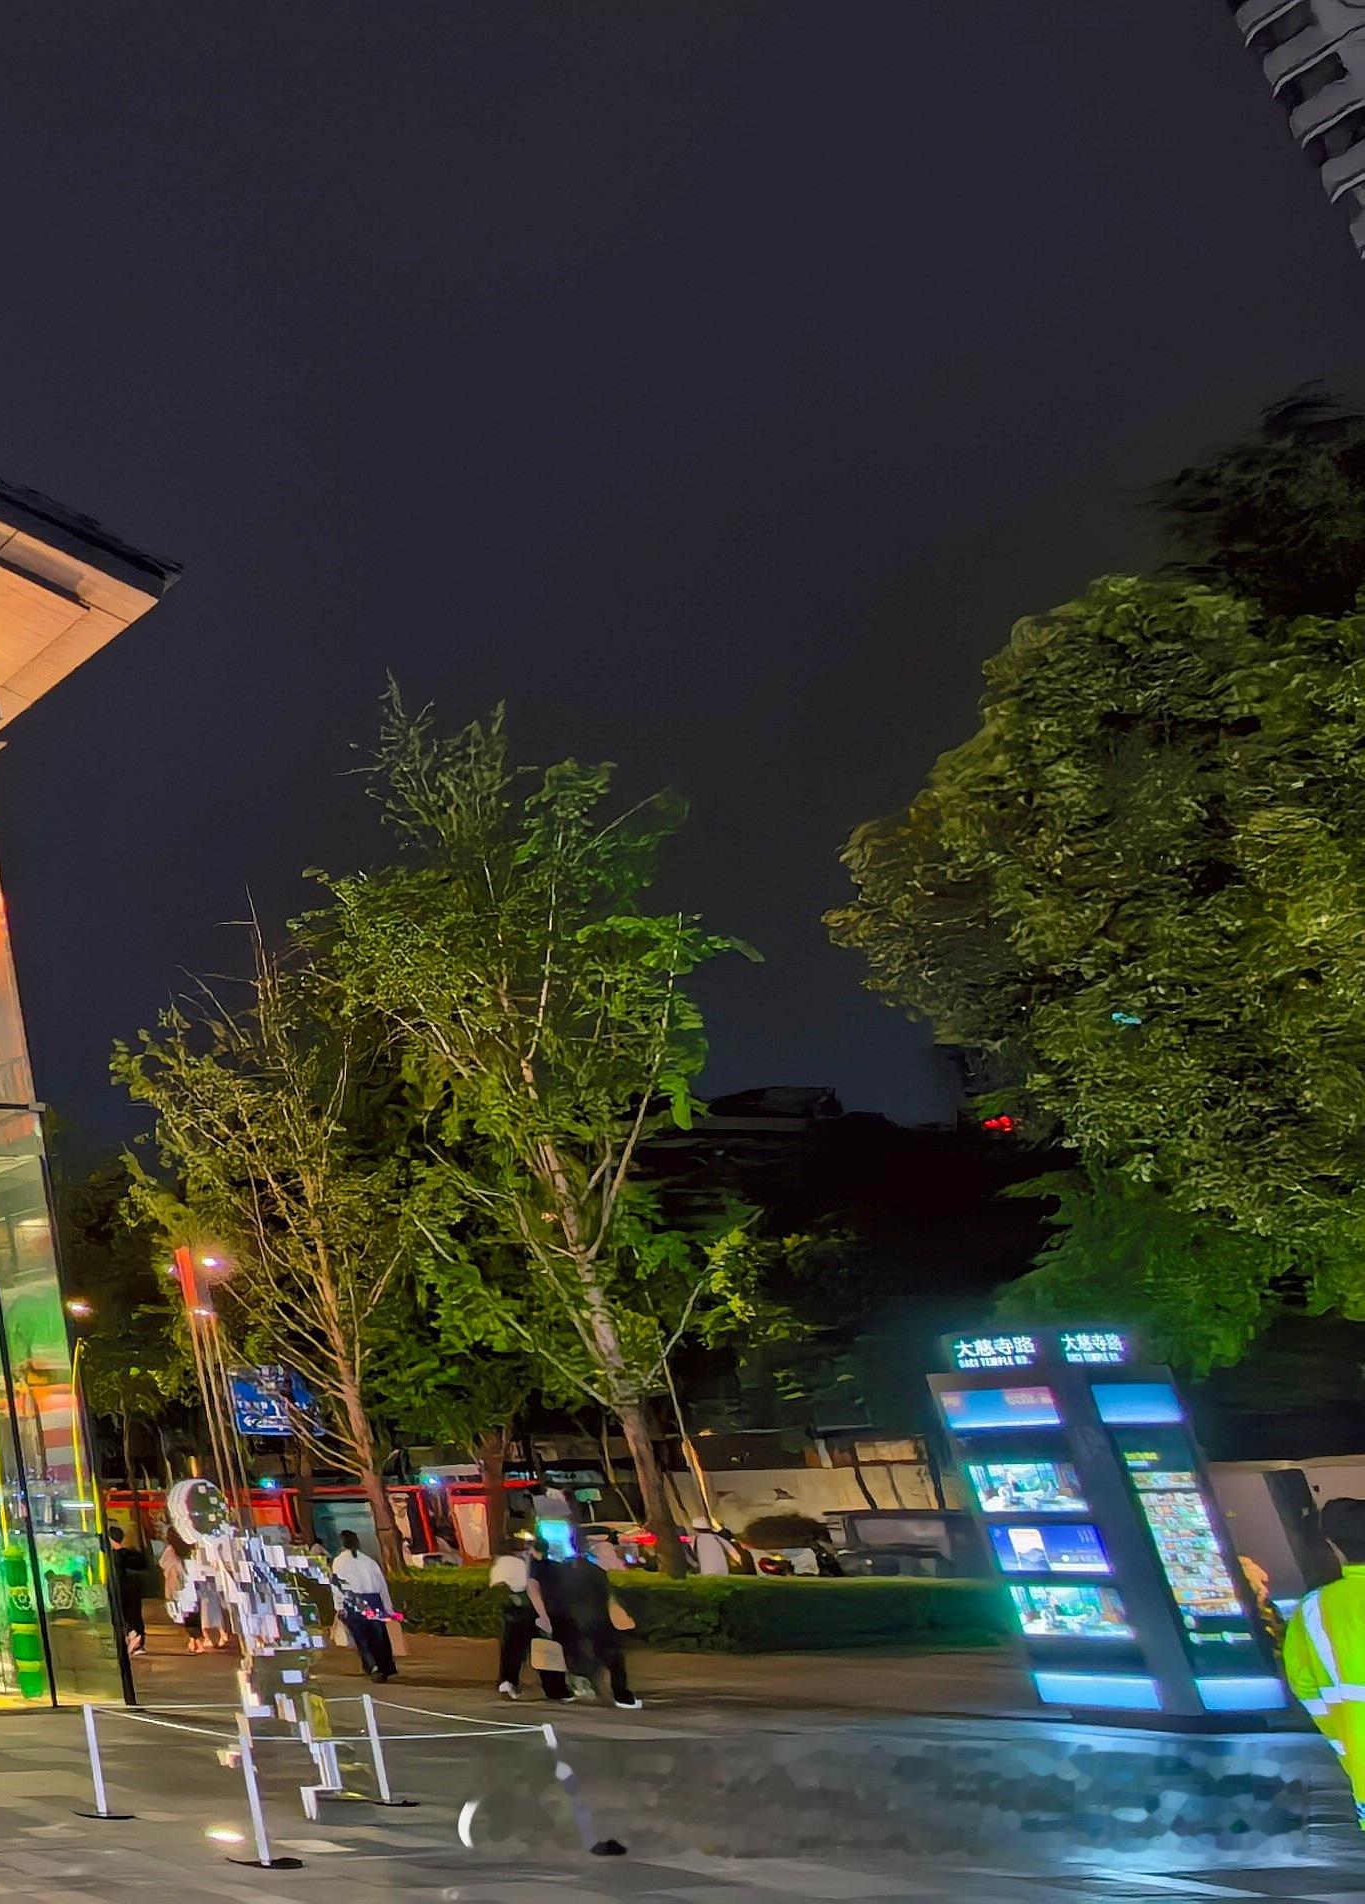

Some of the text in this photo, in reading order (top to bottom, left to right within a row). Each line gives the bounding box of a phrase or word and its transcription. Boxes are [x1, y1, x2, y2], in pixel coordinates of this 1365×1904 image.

[954, 1335, 1036, 1358] 大慈寺路
[1061, 1332, 1125, 1352] 大慈寺路
